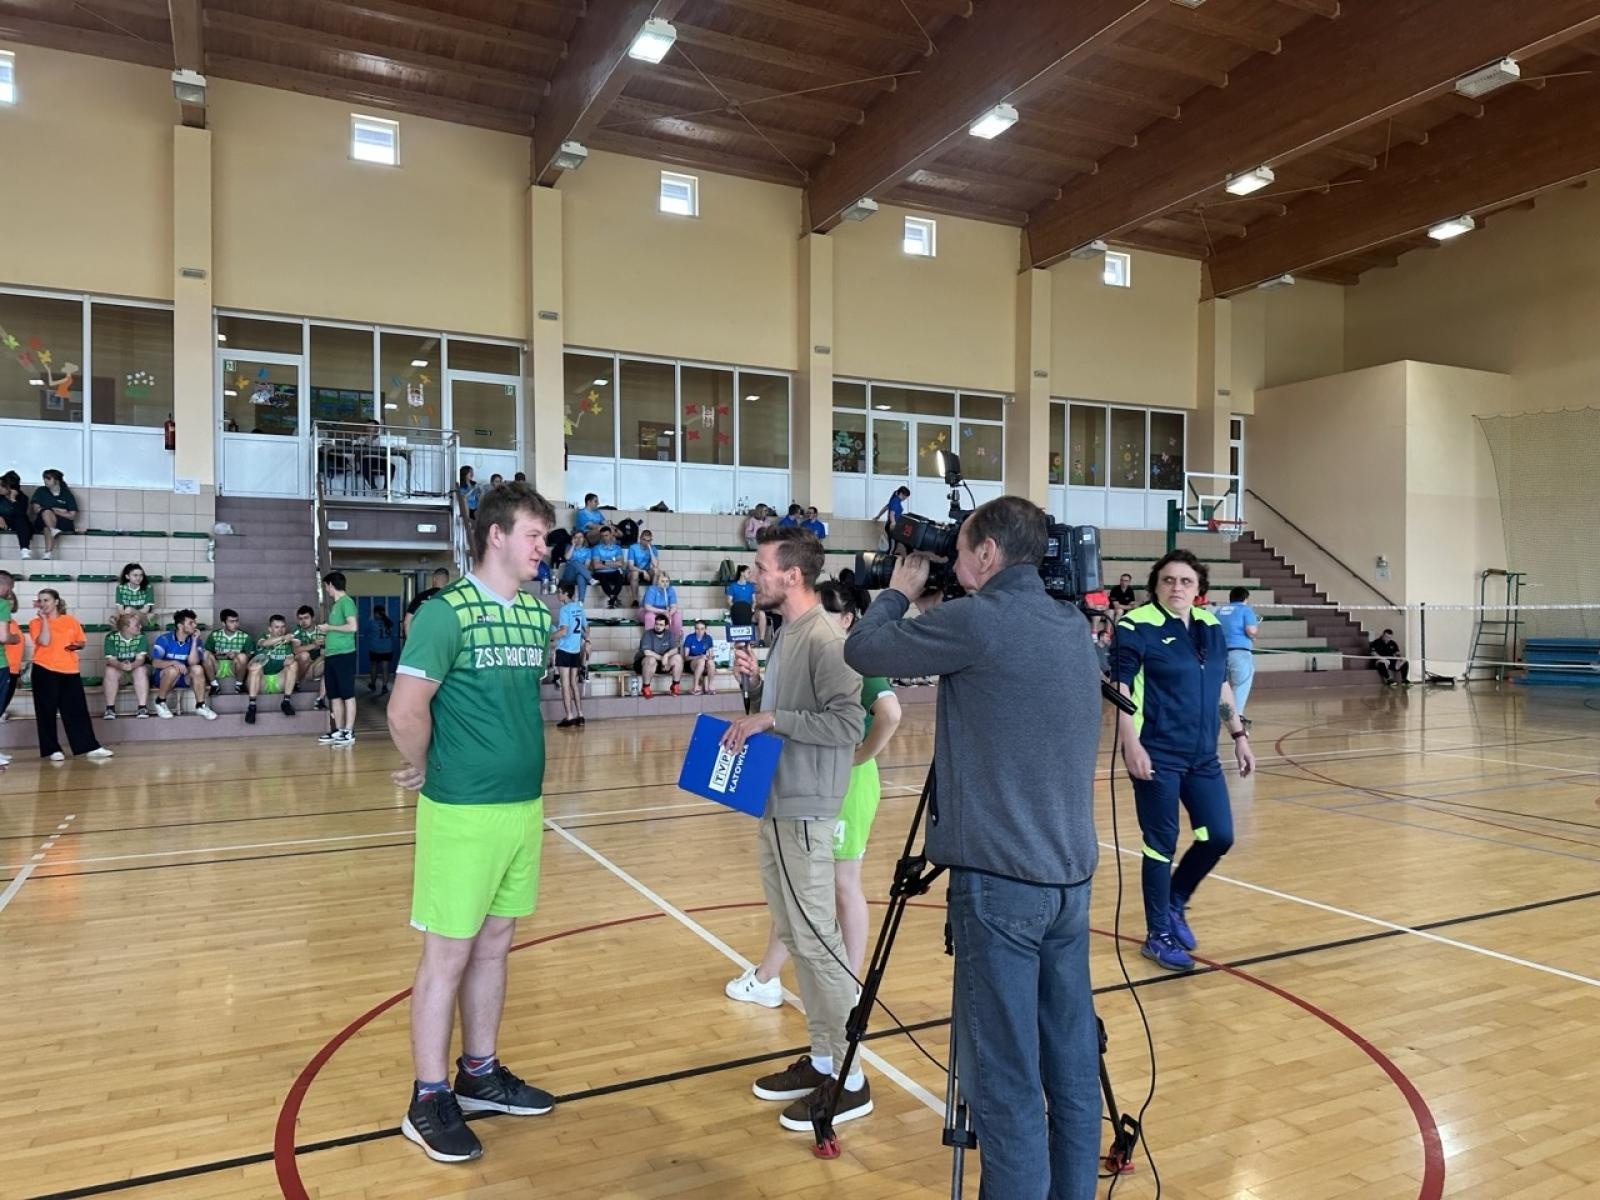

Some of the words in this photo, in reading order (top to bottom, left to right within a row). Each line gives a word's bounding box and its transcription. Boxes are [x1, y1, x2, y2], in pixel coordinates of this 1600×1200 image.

[573, 617, 581, 634] 2
[474, 647, 503, 669] ZSS
[714, 754, 730, 783] TVP
